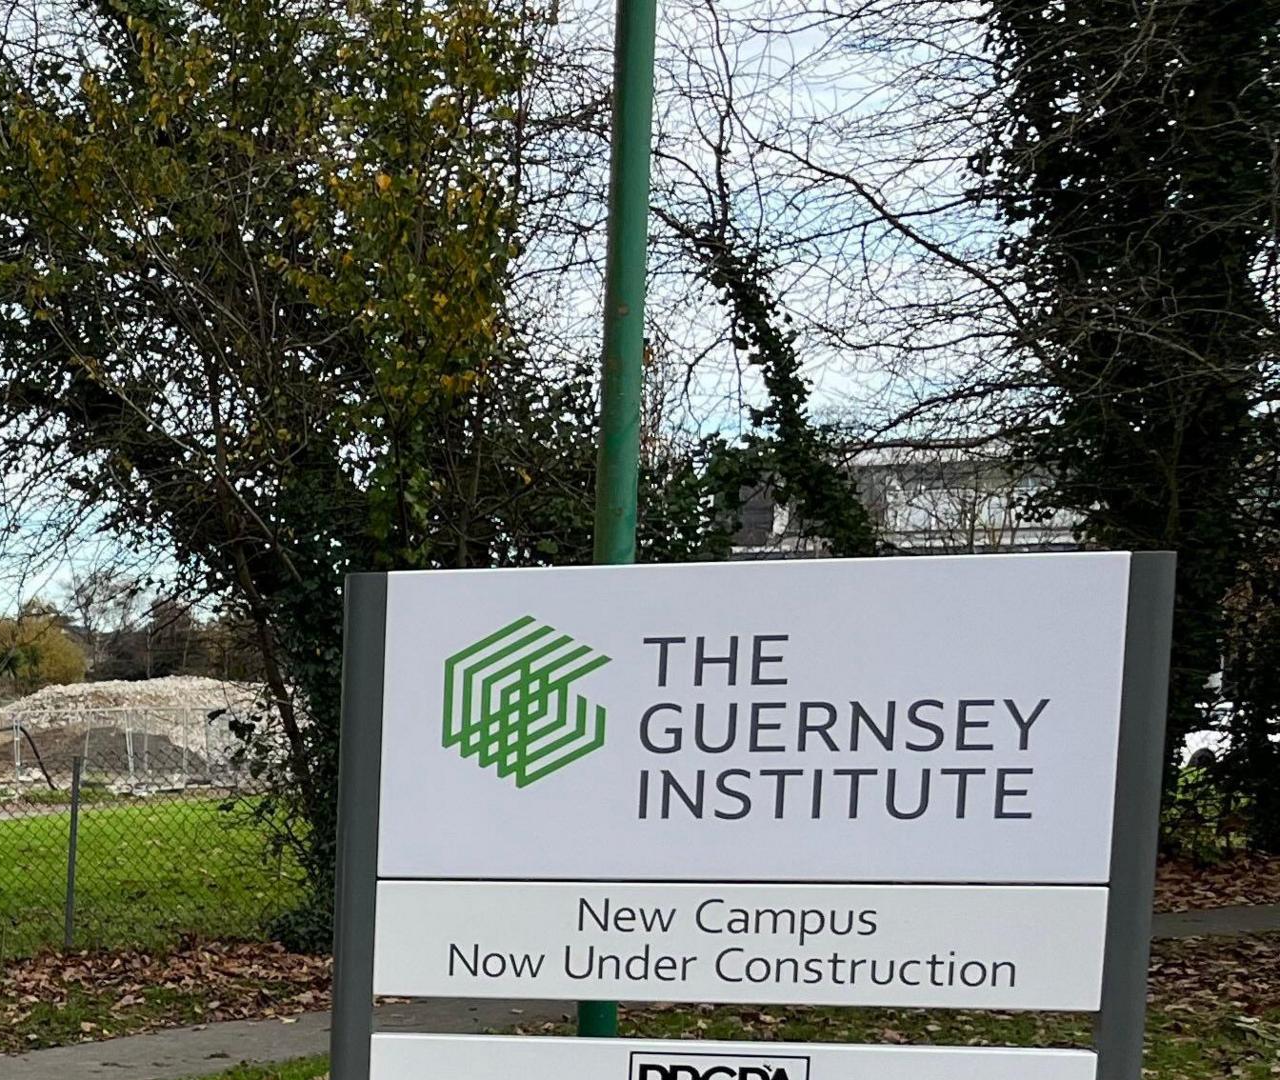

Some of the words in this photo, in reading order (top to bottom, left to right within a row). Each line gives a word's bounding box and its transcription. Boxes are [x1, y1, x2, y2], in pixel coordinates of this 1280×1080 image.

[643, 634, 789, 688] THE
[639, 698, 1051, 755] GUERNSEY
[638, 767, 1034, 821] INSTITUTE
[577, 897, 676, 934] New
[695, 898, 877, 947] Campus
[448, 943, 545, 979] Now
[564, 943, 698, 982] Under
[715, 946, 1017, 988] Construction
